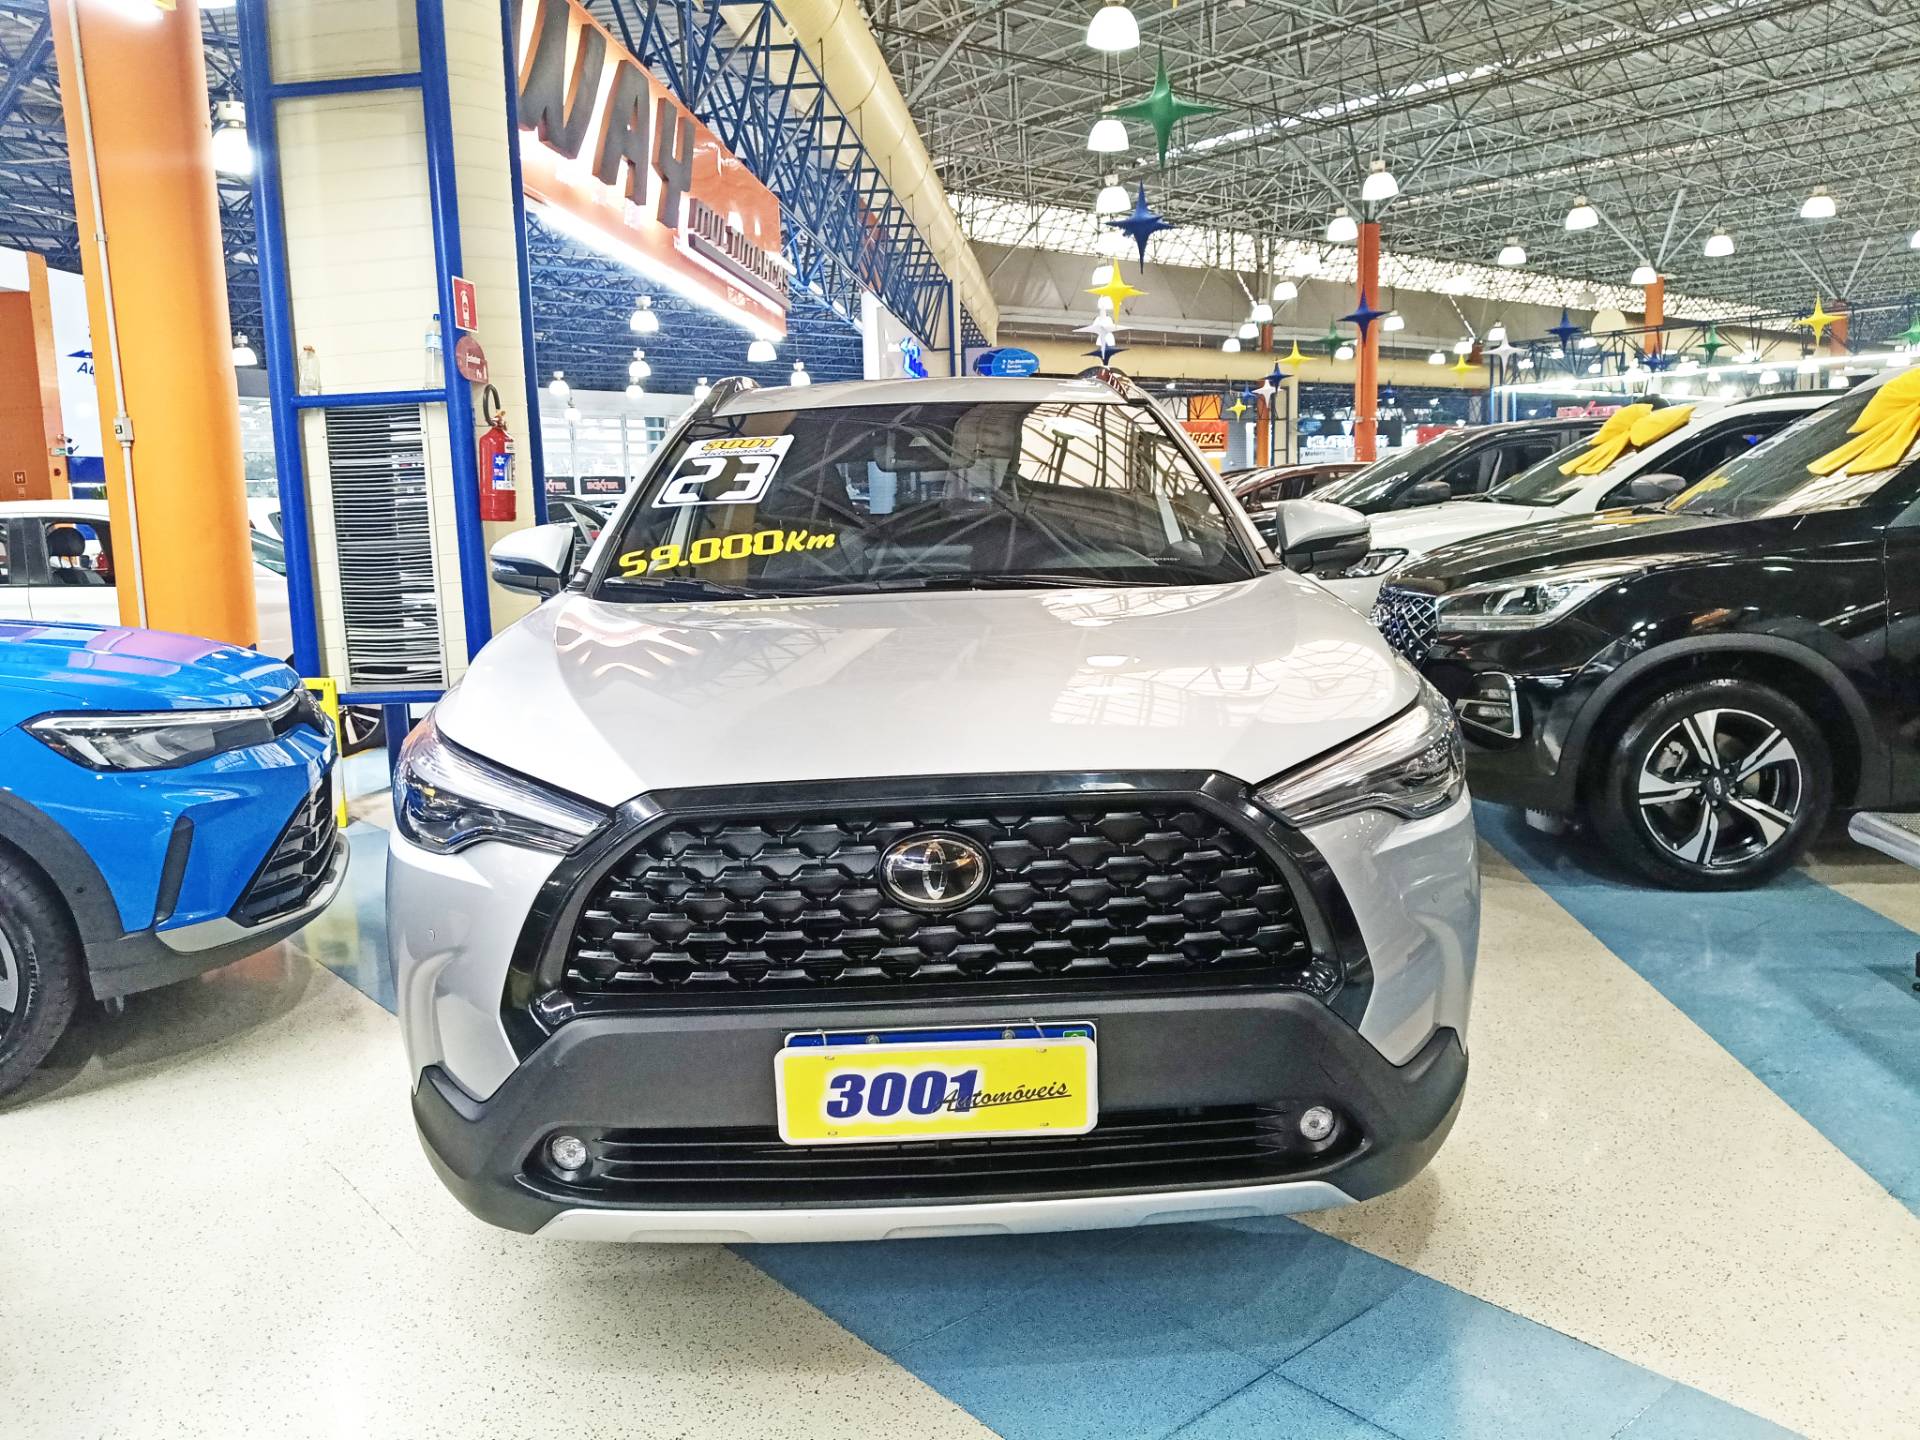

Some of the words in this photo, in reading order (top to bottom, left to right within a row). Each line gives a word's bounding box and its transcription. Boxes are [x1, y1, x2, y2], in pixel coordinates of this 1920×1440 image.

[688, 198, 791, 298] MULTIMARCAS
[702, 437, 778, 451] 3001
[662, 456, 776, 501] 23
[618, 529, 836, 577] 59.000Km
[826, 1069, 979, 1119] 3001
[932, 1081, 1069, 1114] Automóveis
